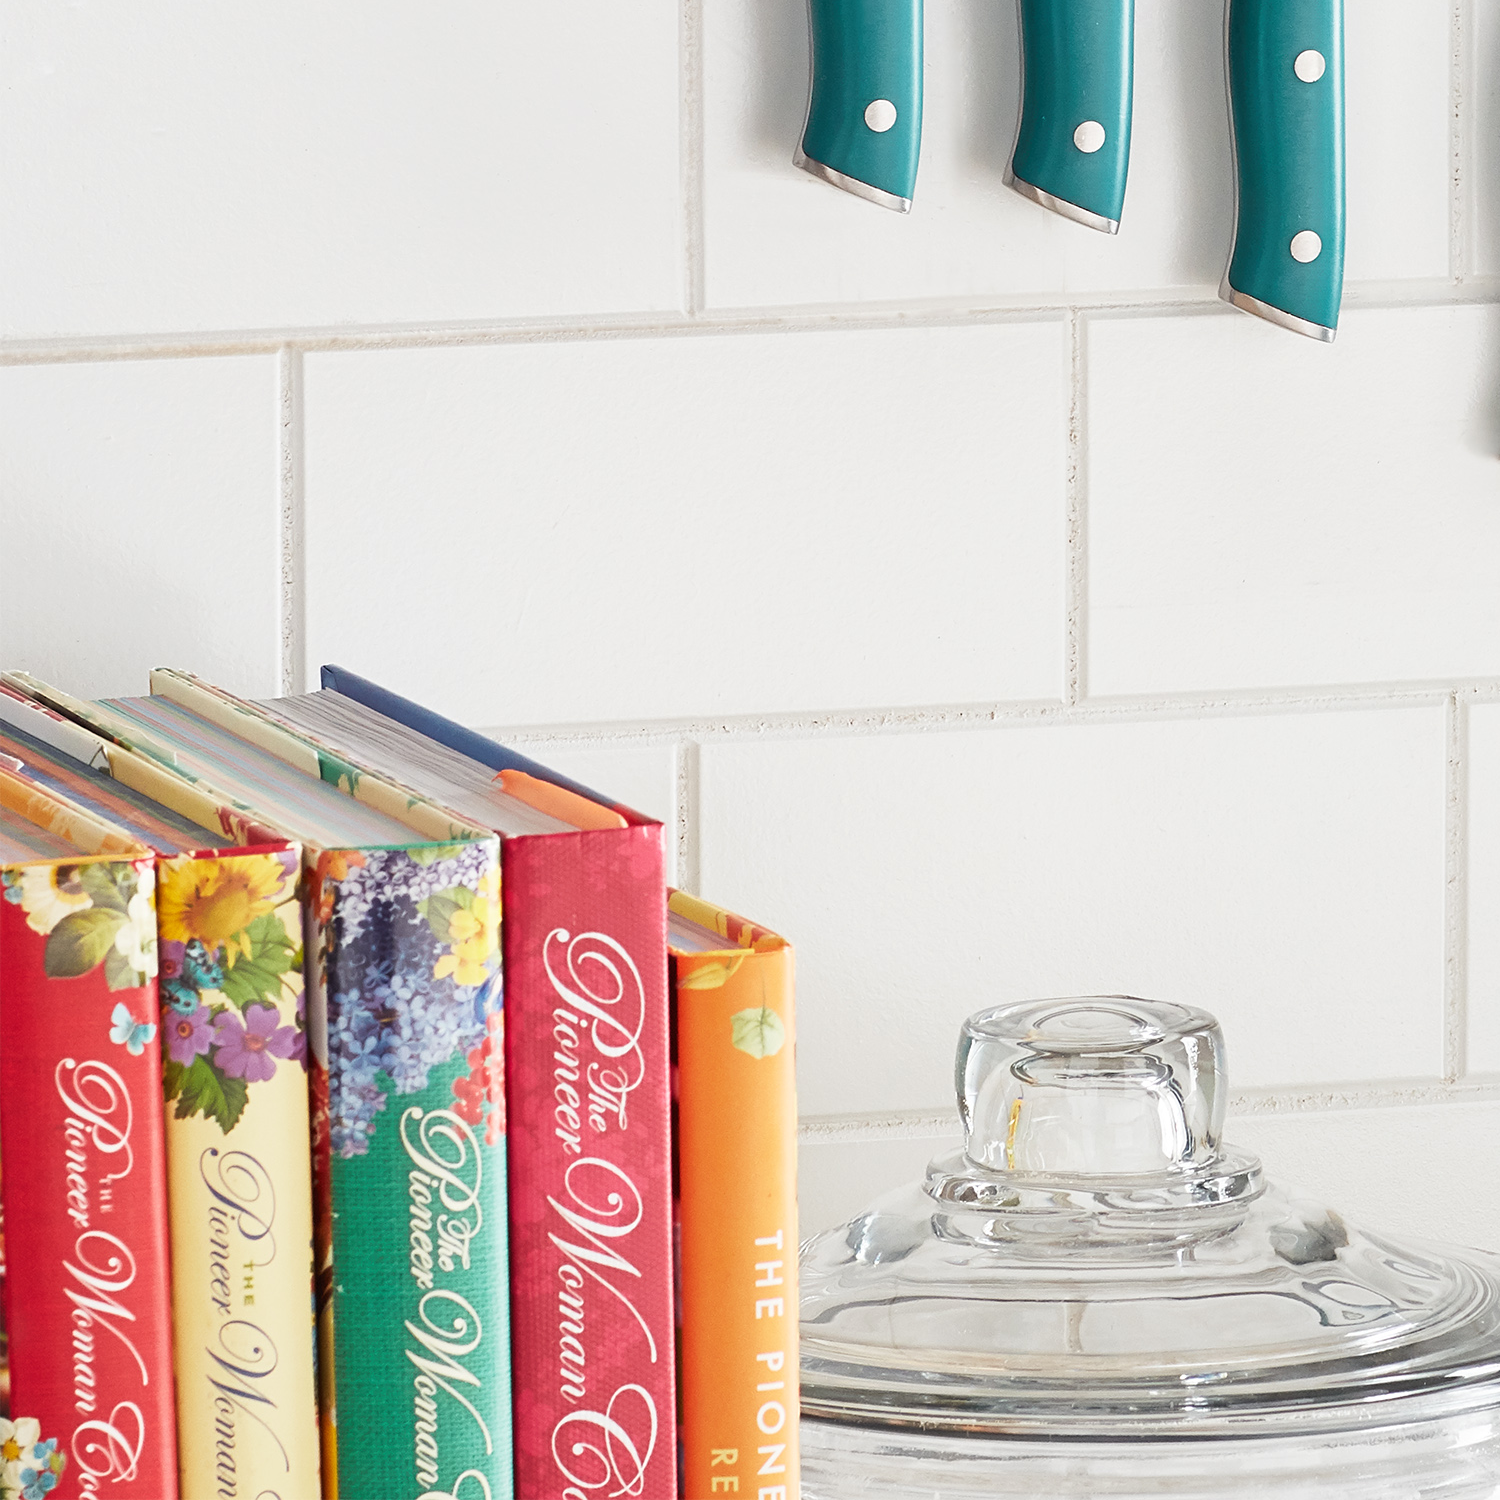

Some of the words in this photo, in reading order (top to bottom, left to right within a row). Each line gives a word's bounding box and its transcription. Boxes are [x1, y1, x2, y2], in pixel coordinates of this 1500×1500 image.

[543, 927, 645, 1155] Pioneer
[587, 1062, 628, 1133] The
[55, 1057, 133, 1229] Pioneer
[99, 1178, 113, 1213] THE
[400, 1106, 482, 1290] Pioneer
[199, 1147, 276, 1316] Pioneer
[243, 1260, 255, 1306] THE
[436, 1214, 471, 1273] The
[546, 1157, 657, 1404] Woman
[754, 1229, 784, 1319] THE
[62, 1230, 148, 1416] Woman
[404, 1289, 493, 1490] Woman
[205, 1320, 290, 1500] Woman
[710, 1448, 740, 1493] RE
[756, 1351, 787, 1500] PIONE
